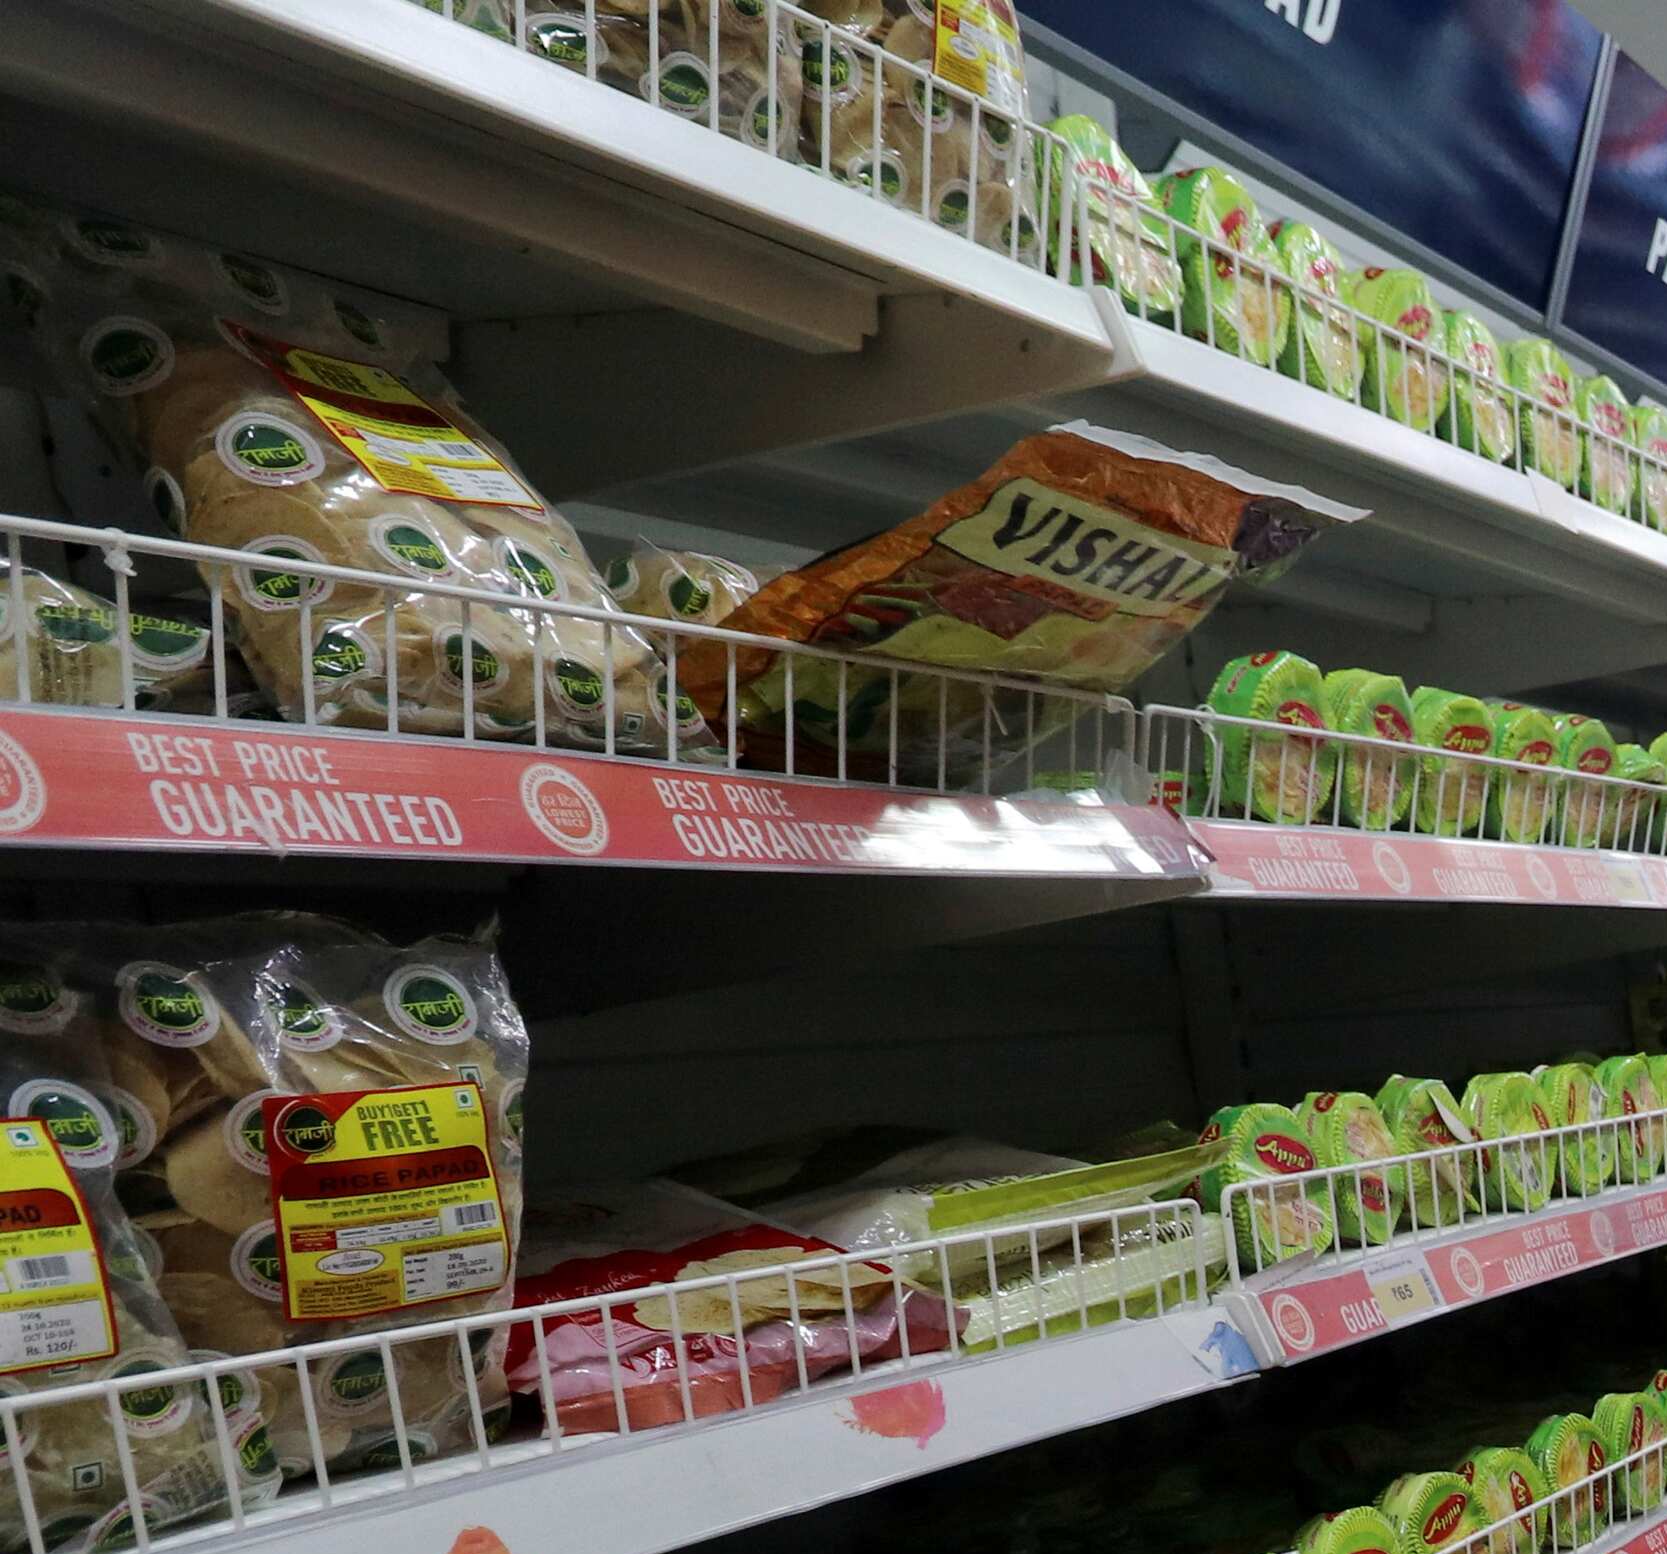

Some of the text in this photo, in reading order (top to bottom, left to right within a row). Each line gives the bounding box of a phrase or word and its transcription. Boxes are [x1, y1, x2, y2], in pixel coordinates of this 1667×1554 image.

[128, 733, 340, 786] BEST PRICE
[150, 779, 464, 848] GUARANTEED
[653, 777, 795, 818] BEST PRICE
[1251, 858, 1360, 892] GUARANTEED
[361, 1117, 439, 1151] FREE
[319, 1159, 480, 1193] RICE PAPAD
[1392, 1284, 1413, 1300] ₹65
